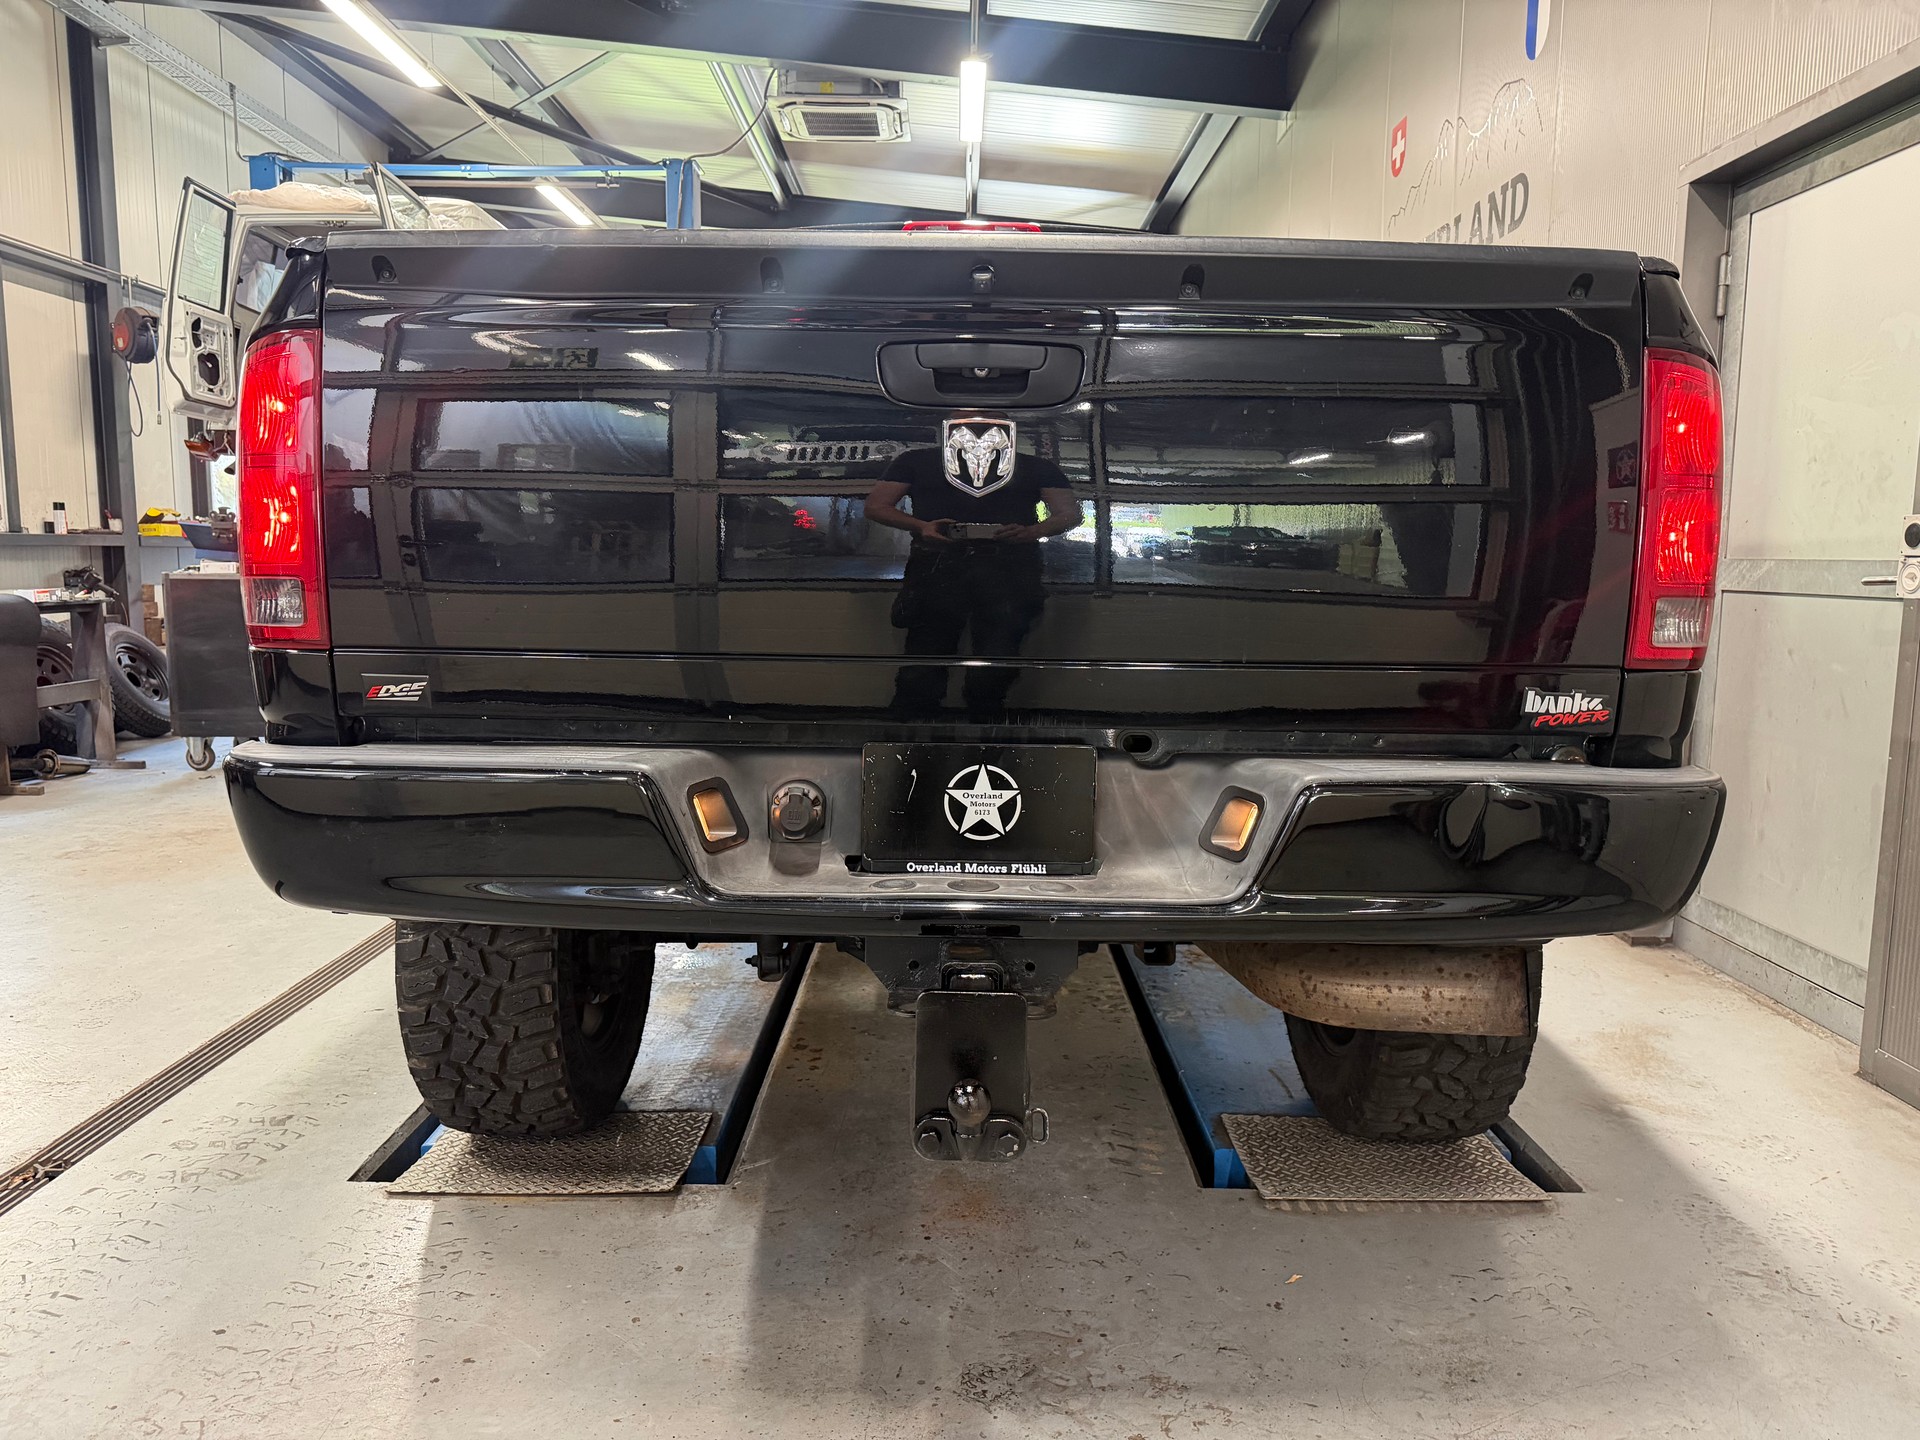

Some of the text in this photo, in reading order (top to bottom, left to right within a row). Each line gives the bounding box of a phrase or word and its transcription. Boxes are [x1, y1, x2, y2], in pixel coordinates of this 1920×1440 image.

[366, 681, 428, 698] EDGE
[1524, 690, 1603, 715] banks
[1534, 710, 1610, 727] POWER
[962, 792, 1003, 800] Overland
[906, 862, 1047, 875] Overland Motors Flühli
